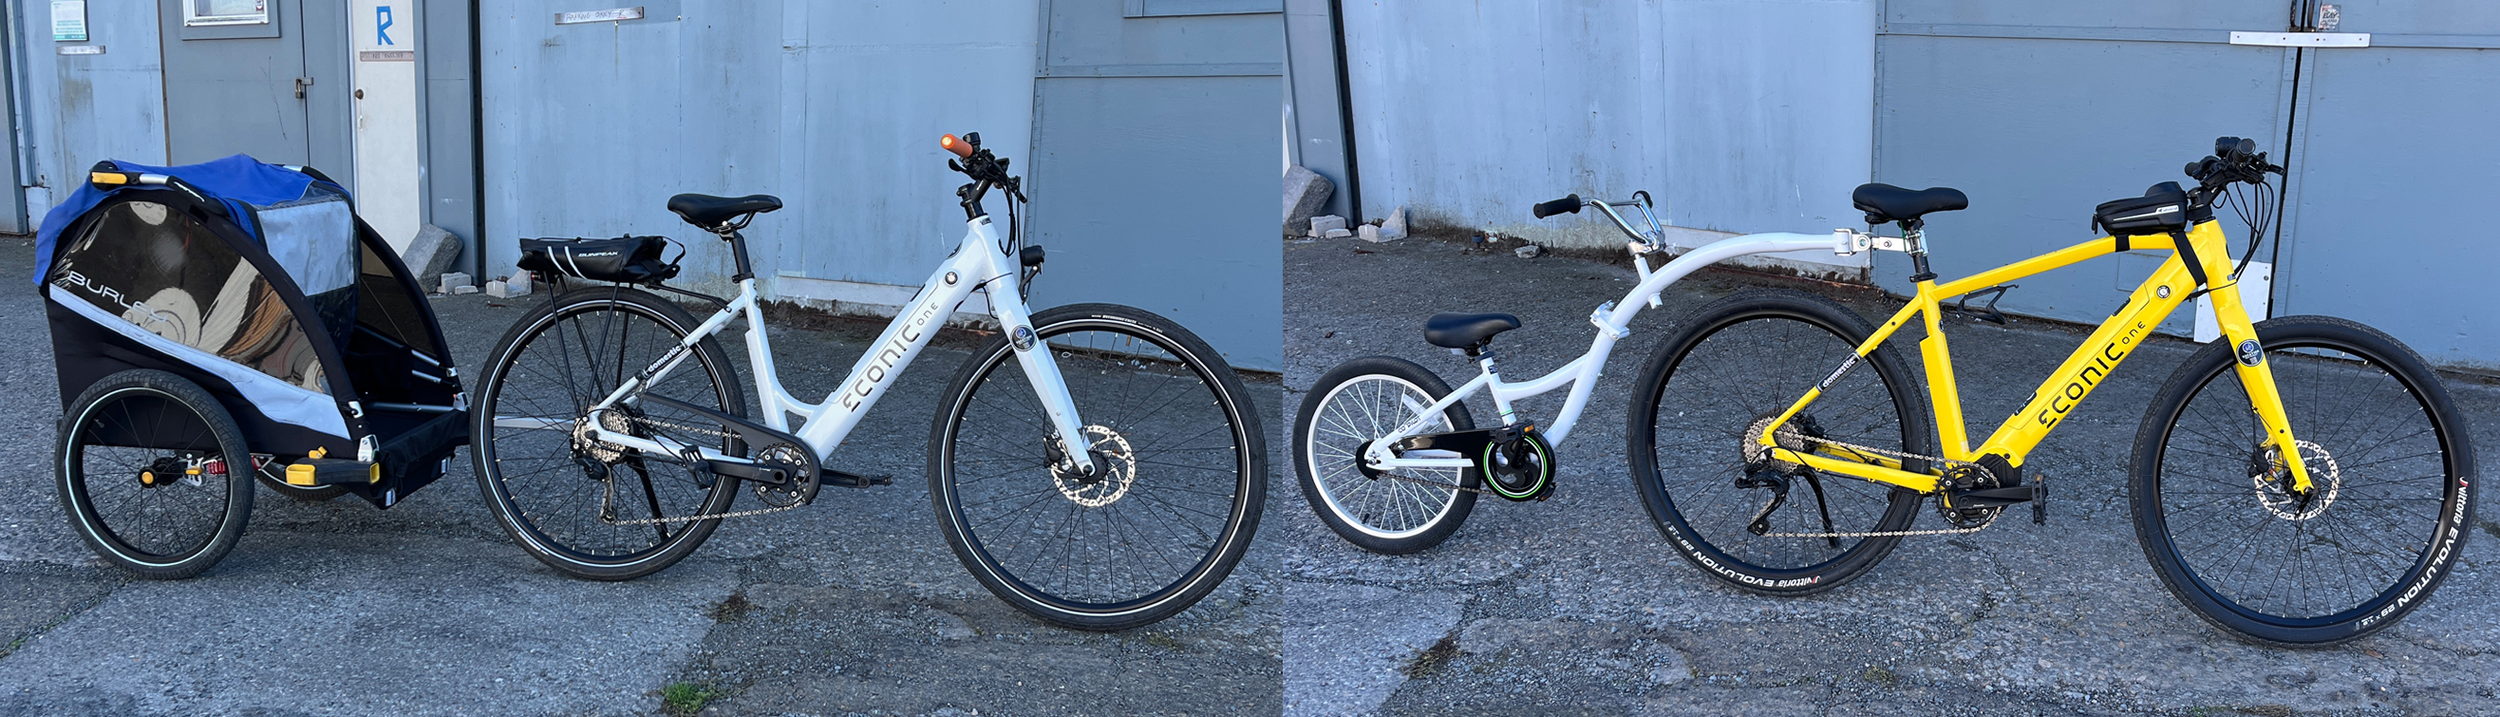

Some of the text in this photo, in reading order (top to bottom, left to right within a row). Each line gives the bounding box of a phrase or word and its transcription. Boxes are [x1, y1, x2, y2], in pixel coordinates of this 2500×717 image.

[376, 5, 394, 45] R
[67, 270, 169, 322] BURLEY
[648, 345, 681, 372] domestic
[843, 324, 920, 412] ECONIC
[1823, 358, 1856, 388] domestic
[2038, 343, 2124, 429] ECONIC
[2453, 485, 2468, 526] vittoria
[1681, 539, 1695, 551] 29
[1693, 550, 1775, 587] EVOLUTION
[1778, 577, 1814, 588] vittoria
[2397, 526, 2459, 608] EVOLUTION
[2380, 603, 2396, 617] 29
